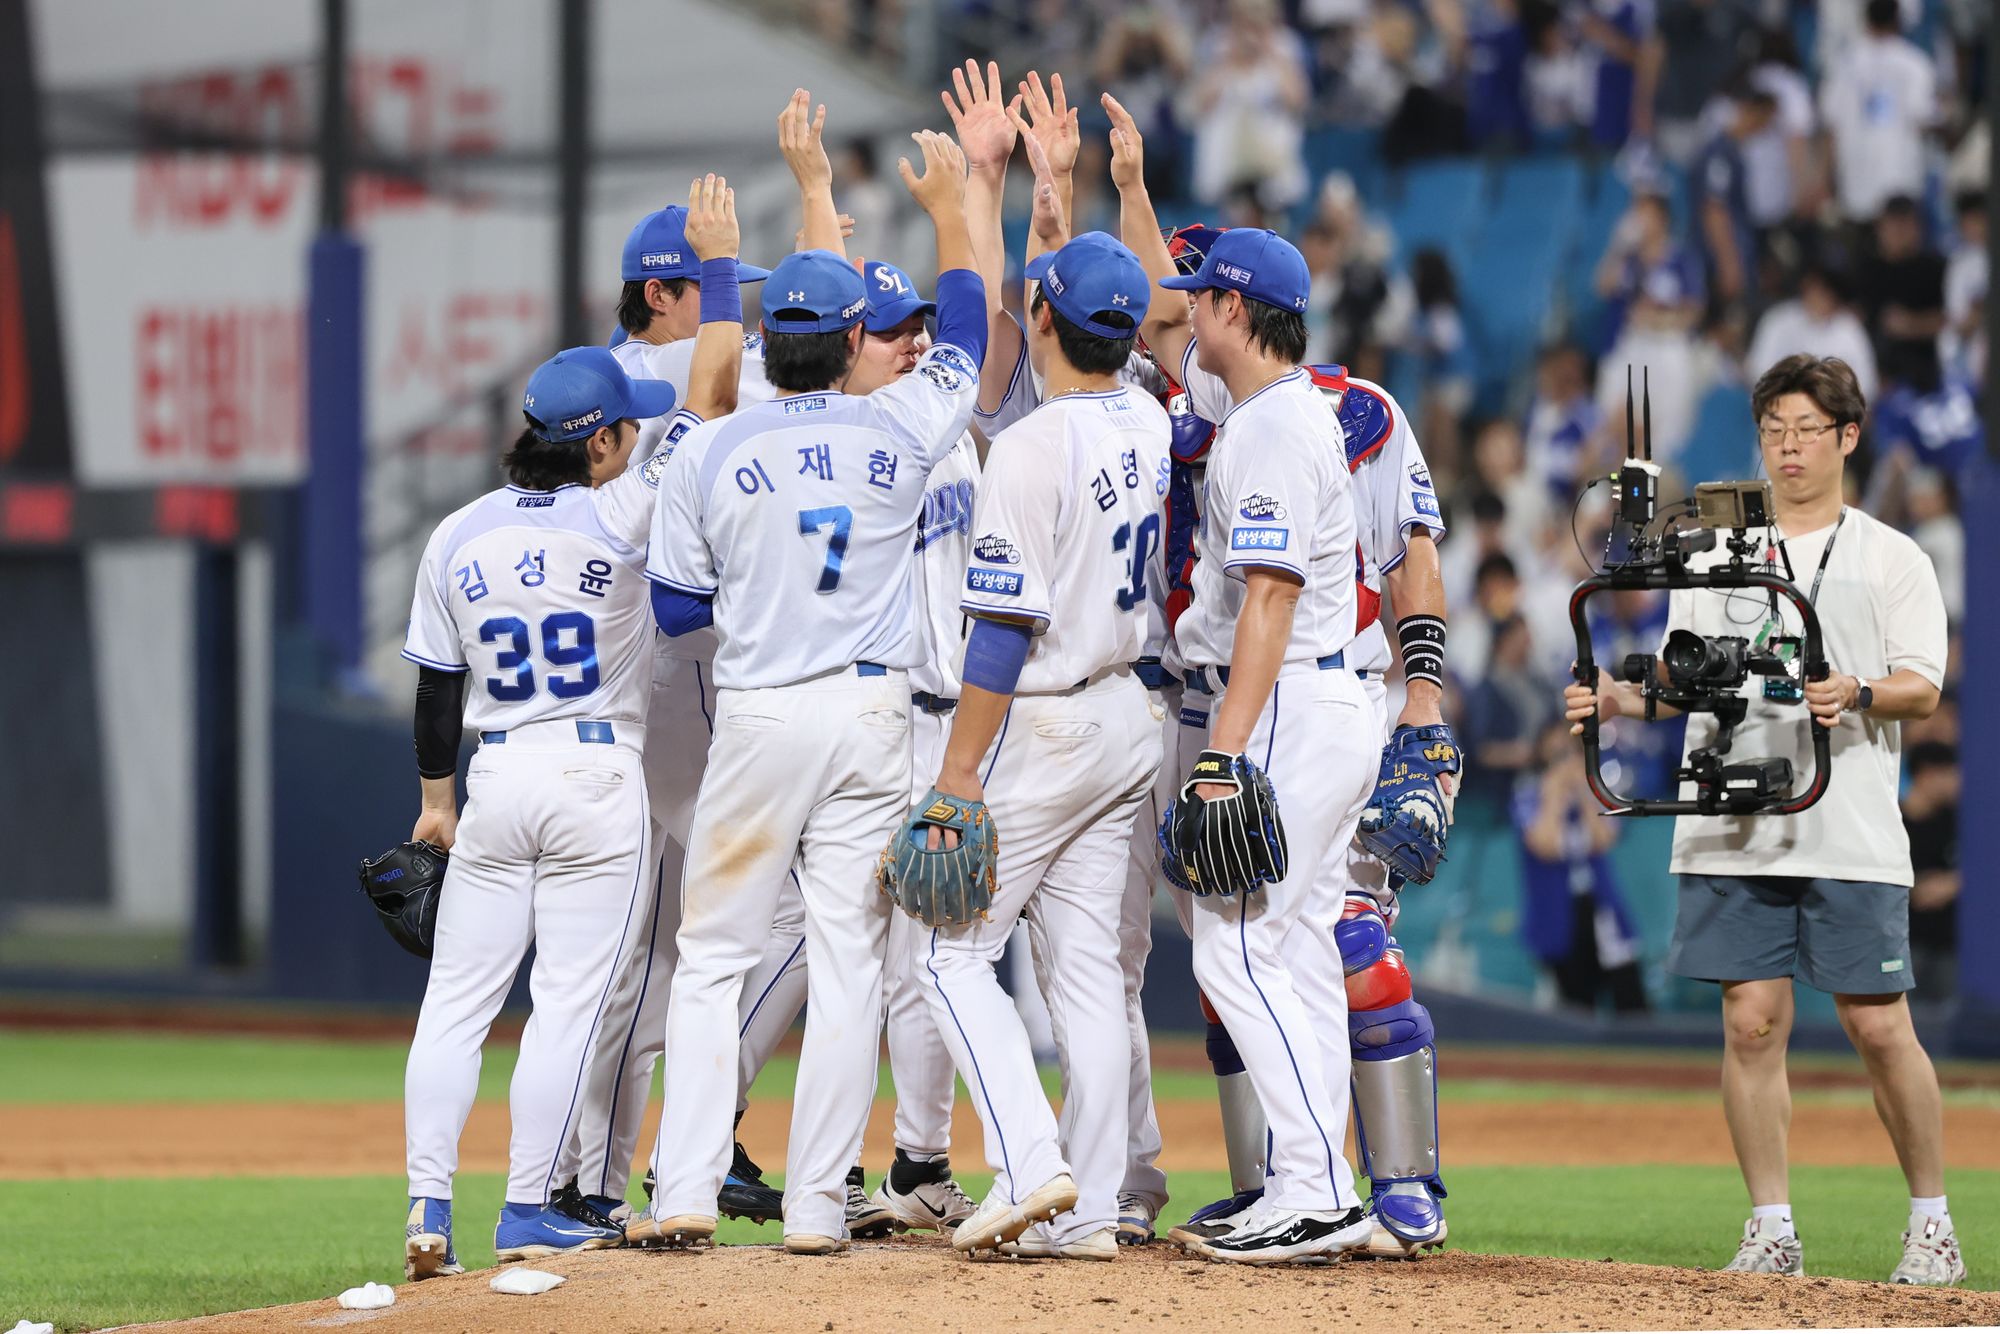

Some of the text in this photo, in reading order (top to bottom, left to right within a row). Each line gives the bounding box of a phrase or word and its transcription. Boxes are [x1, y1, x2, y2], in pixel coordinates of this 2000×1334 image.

[641, 253, 682, 267] 대구대학교
[1216, 261, 1252, 285] iM뱅크
[785, 398, 827, 414] 삼성카드
[563, 409, 603, 431] 대구대학교
[735, 443, 898, 495] 이재현
[519, 497, 554, 507] 삼성카드
[1241, 496, 1261, 509] WIN
[1250, 503, 1277, 517] WOW
[975, 537, 996, 549] WIN
[1236, 530, 1283, 546] 삼성생명
[796, 504, 855, 595] 7
[984, 545, 1012, 558] WOW
[455, 549, 613, 603] 김성윤
[971, 571, 1018, 591] 삼성생명
[478, 610, 601, 702] 39
[1407, 771, 1430, 782] Keep
